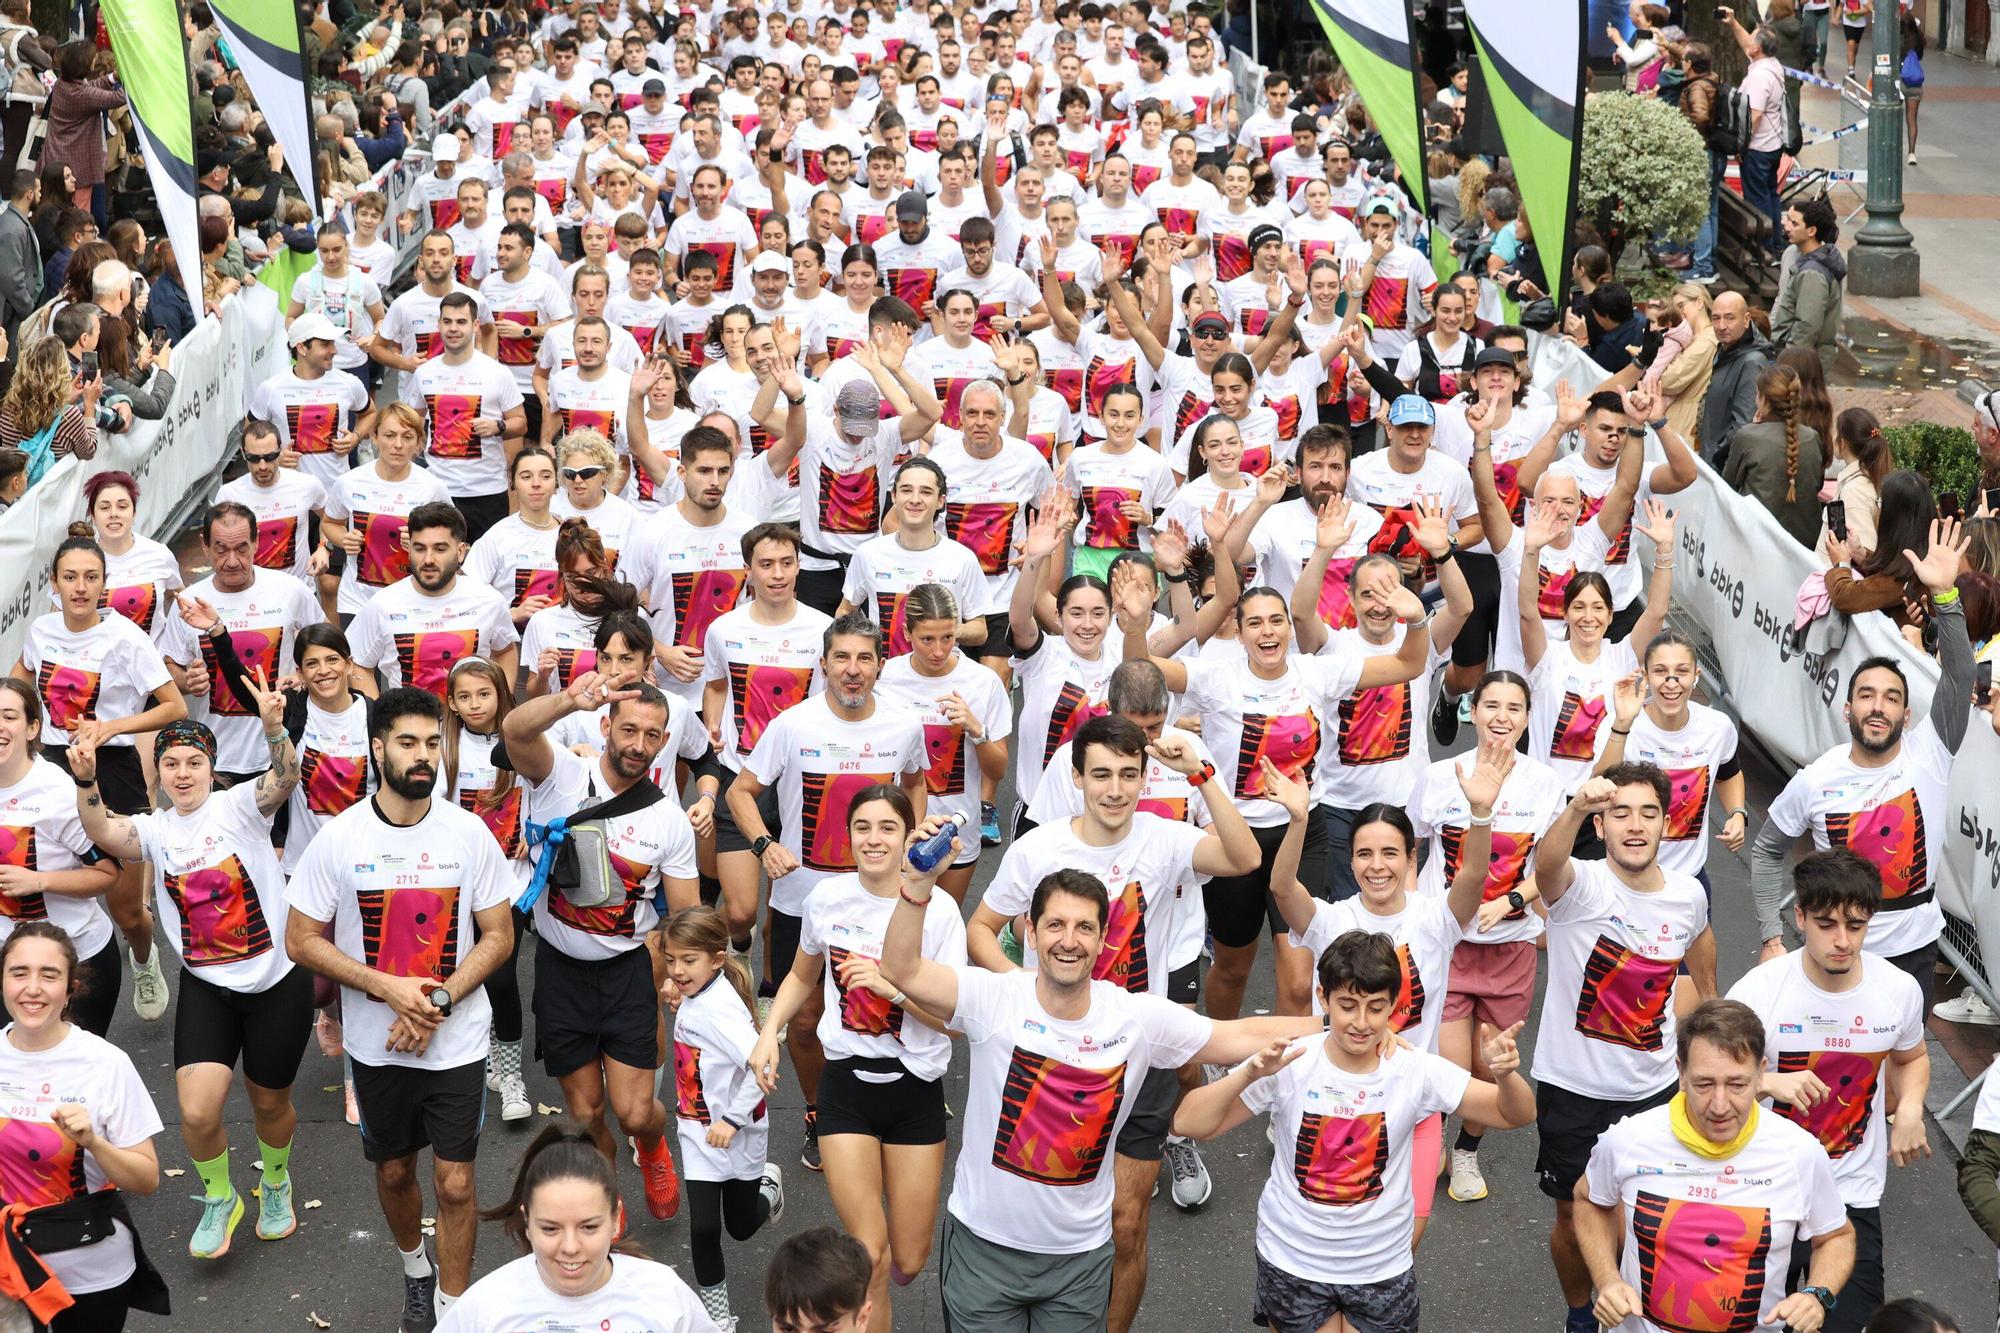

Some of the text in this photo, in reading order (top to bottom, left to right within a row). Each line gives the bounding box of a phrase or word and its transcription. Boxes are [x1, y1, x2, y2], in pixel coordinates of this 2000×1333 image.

[1710, 561, 1732, 601] bbk
[1, 597, 21, 635] bbk
[228, 620, 249, 630] 7922
[1754, 602, 1781, 645] bbk
[760, 655, 780, 665] 1266
[838, 761, 862, 771] 0476
[395, 874, 420, 885] 2712
[1114, 961, 1129, 976] 10
[1849, 1027, 1869, 1035] Bilbao
[1873, 1026, 1890, 1034] bbk
[1103, 1038, 1120, 1049] bbk
[1824, 1037, 1850, 1049] 8880
[1078, 1045, 1099, 1053] Bilbao
[11, 1105, 38, 1118] 0293
[1333, 1104, 1356, 1117] 6992
[1717, 1175, 1739, 1185] Bilbao
[1744, 1177, 1764, 1187] bbk
[1688, 1184, 1718, 1200] 2936
[1719, 1295, 1737, 1311] 10
